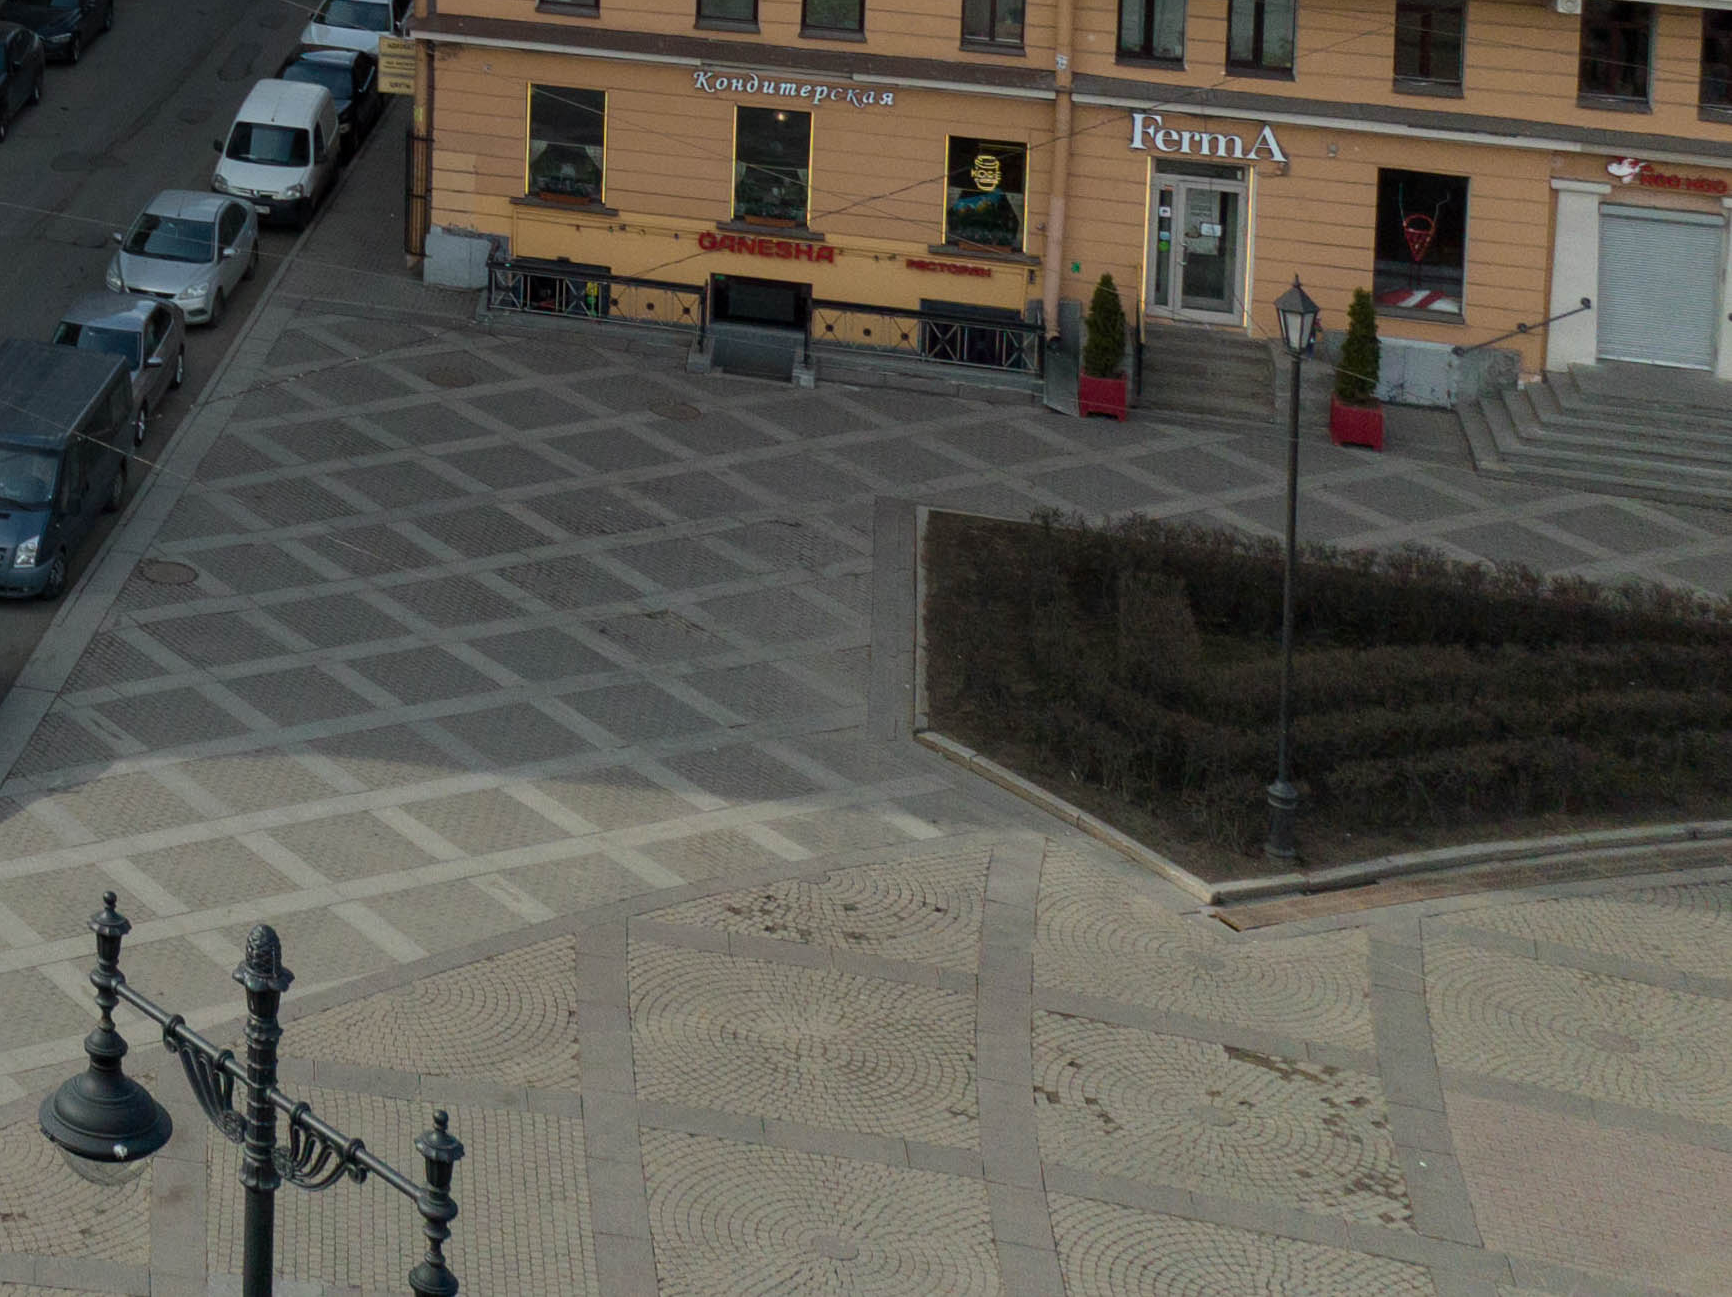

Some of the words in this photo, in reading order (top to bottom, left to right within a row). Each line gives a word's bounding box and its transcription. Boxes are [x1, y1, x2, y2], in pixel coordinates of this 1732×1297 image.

[693, 71, 895, 108] Кондитерская
[1128, 113, 1289, 163] FermA
[697, 231, 836, 264] GANESHA
